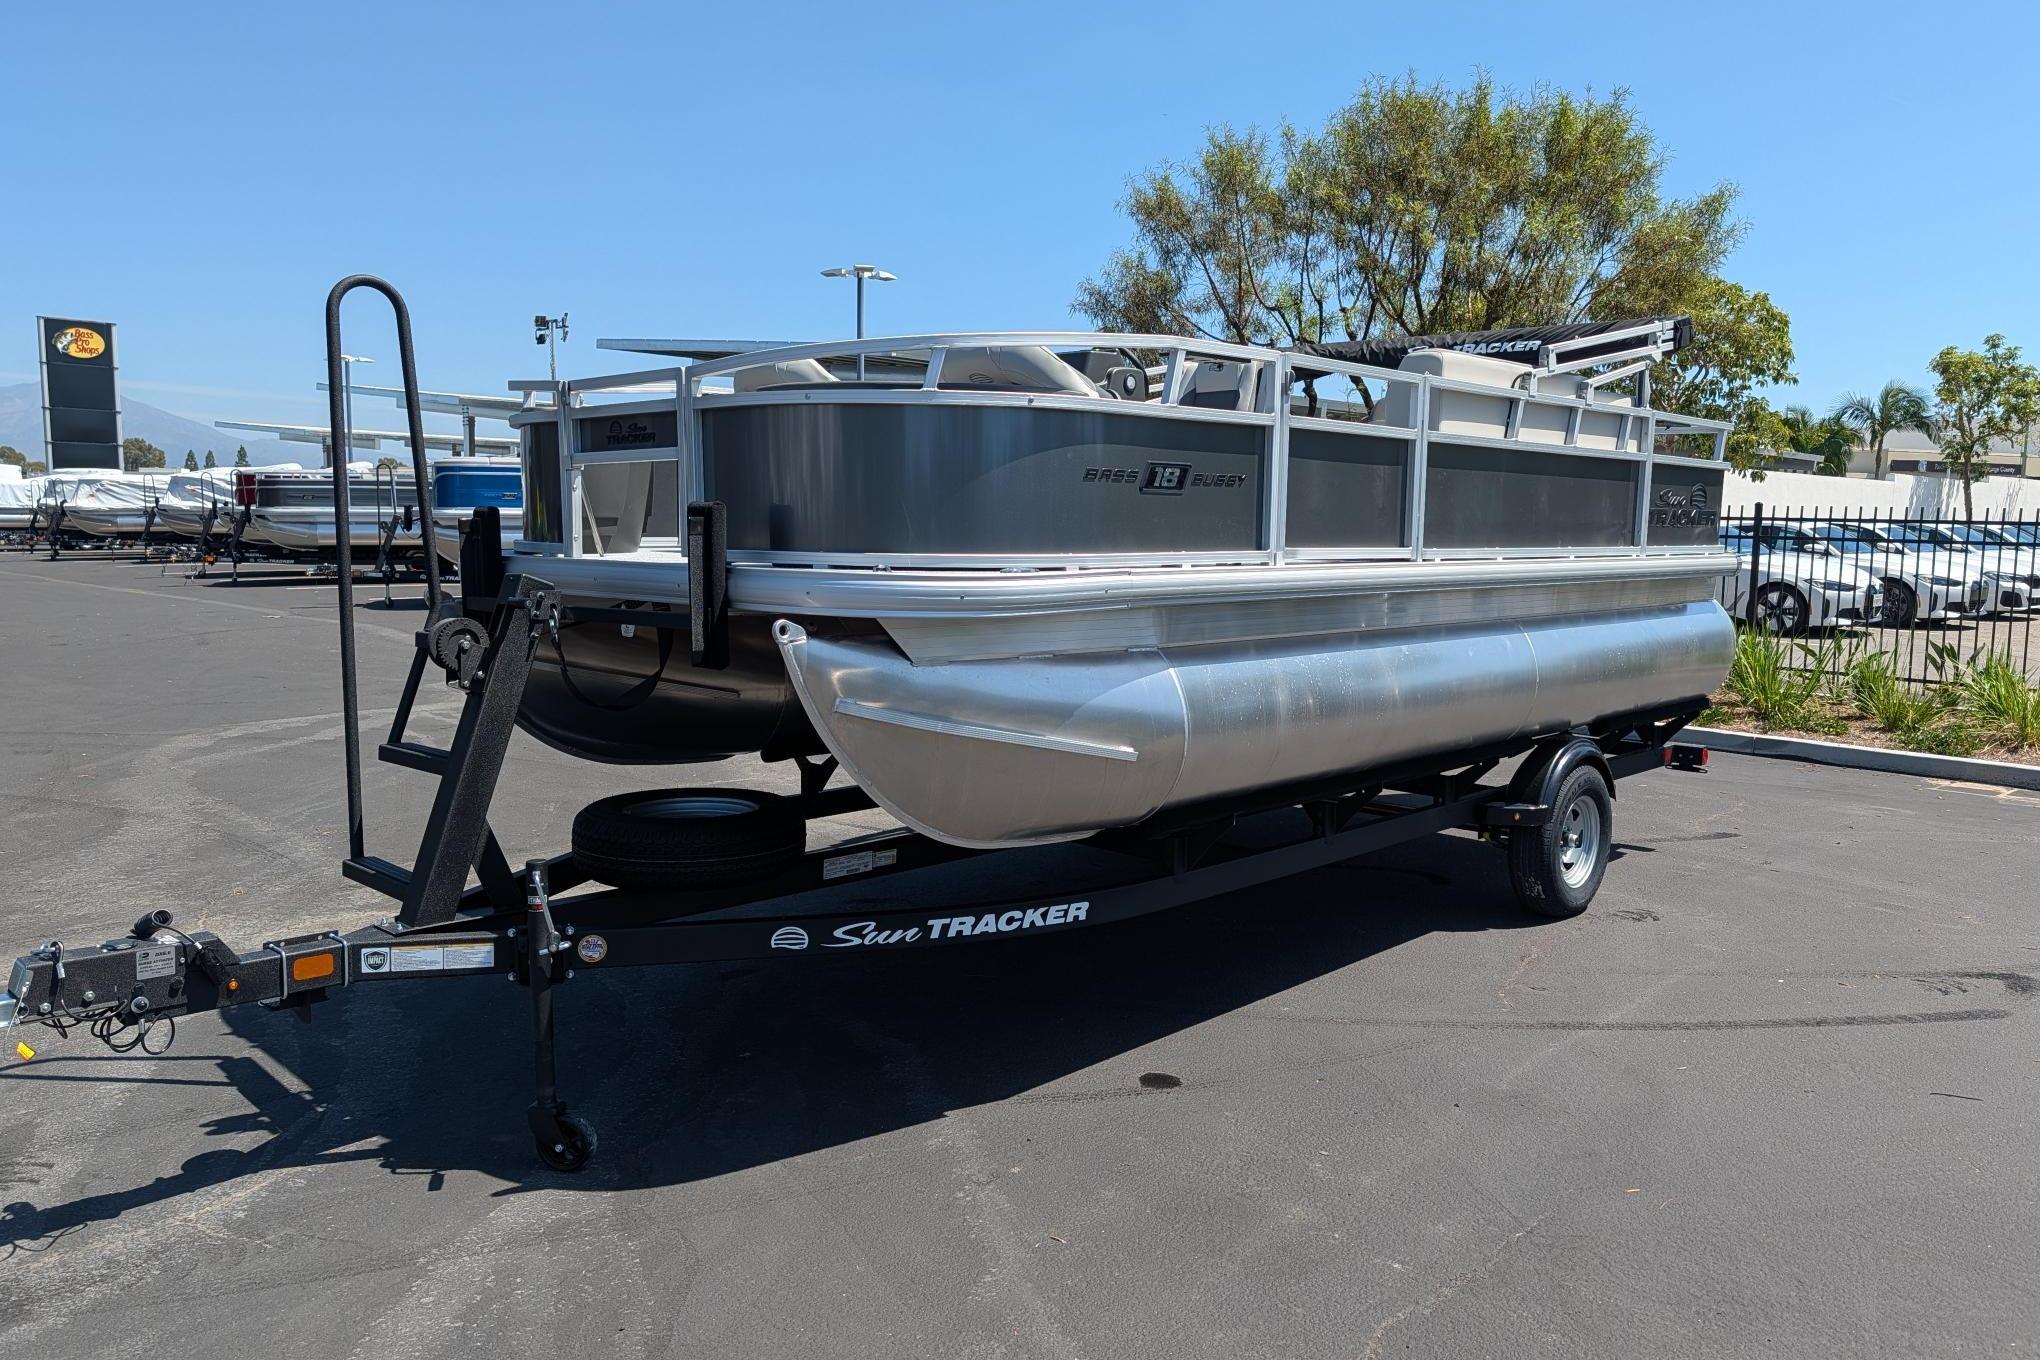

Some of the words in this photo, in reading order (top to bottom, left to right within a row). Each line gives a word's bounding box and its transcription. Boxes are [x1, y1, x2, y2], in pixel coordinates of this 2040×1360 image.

[74, 329, 94, 339] Bass
[75, 337, 90, 347] Pro
[1453, 340, 1542, 354] TRACKER
[75, 345, 100, 356] Shops
[1083, 467, 1140, 484] BASS
[1153, 466, 1181, 487] 18
[1191, 473, 1248, 488] BUGGY
[1655, 488, 1687, 508] Sun
[1649, 508, 1718, 528] TRACKER
[820, 921, 922, 947] Sun
[927, 901, 1090, 940] TRACKER
[367, 955, 384, 965] IMPACT
